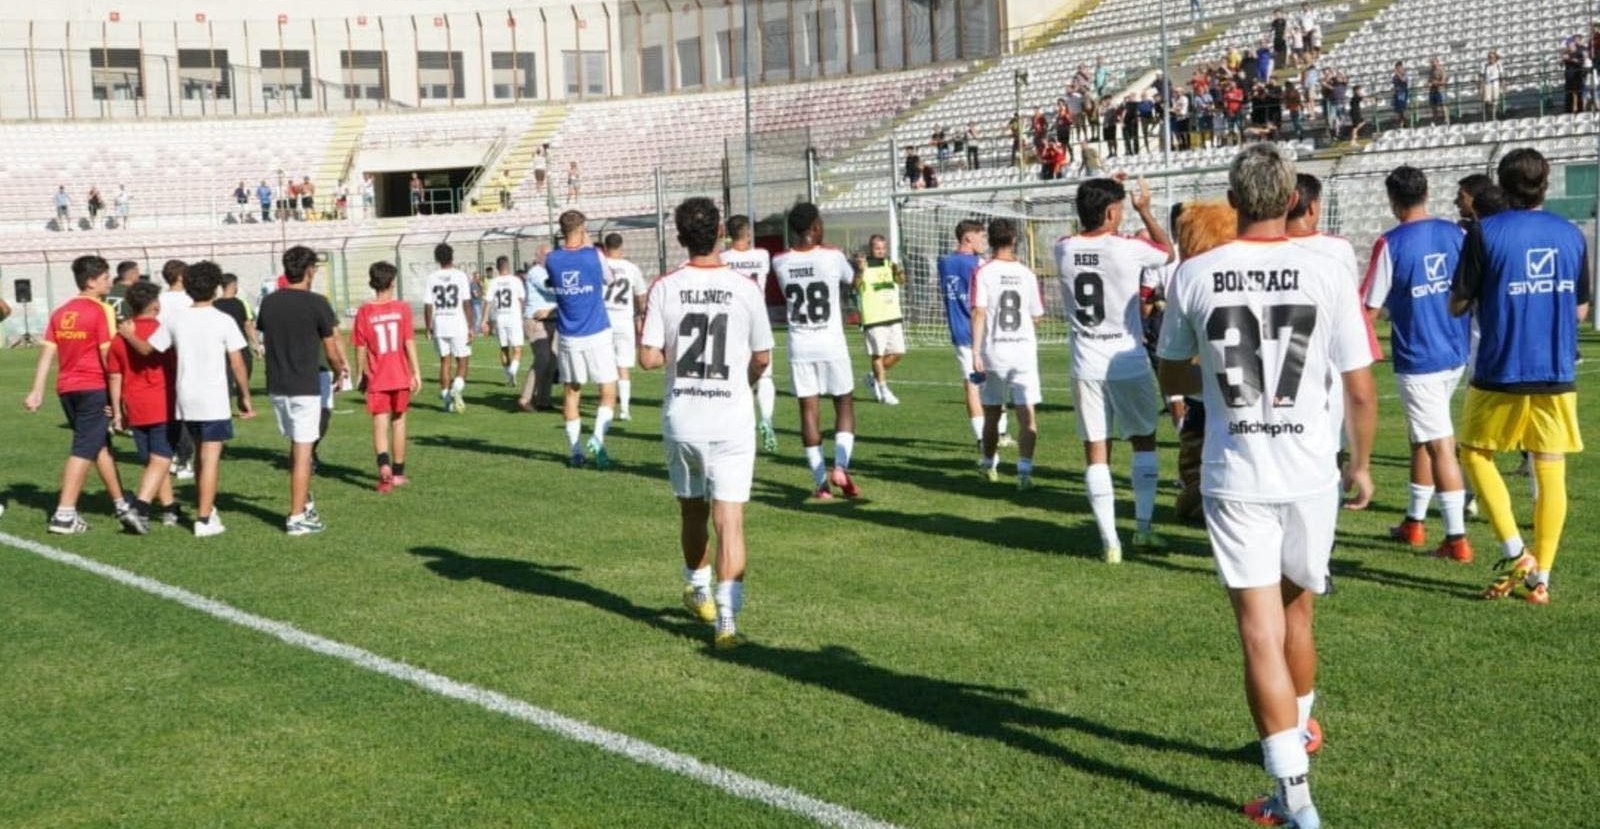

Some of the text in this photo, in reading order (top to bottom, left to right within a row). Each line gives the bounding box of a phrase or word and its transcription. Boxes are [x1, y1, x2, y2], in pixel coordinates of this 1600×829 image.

[1074, 253, 1099, 266] REIS
[433, 284, 459, 309] 33
[495, 288, 512, 310] 13
[785, 281, 831, 324] 28
[998, 289, 1021, 332] 8
[1074, 271, 1105, 328] 9
[373, 321, 399, 355] 11
[676, 312, 730, 380] 21
[1206, 304, 1318, 409] 37
